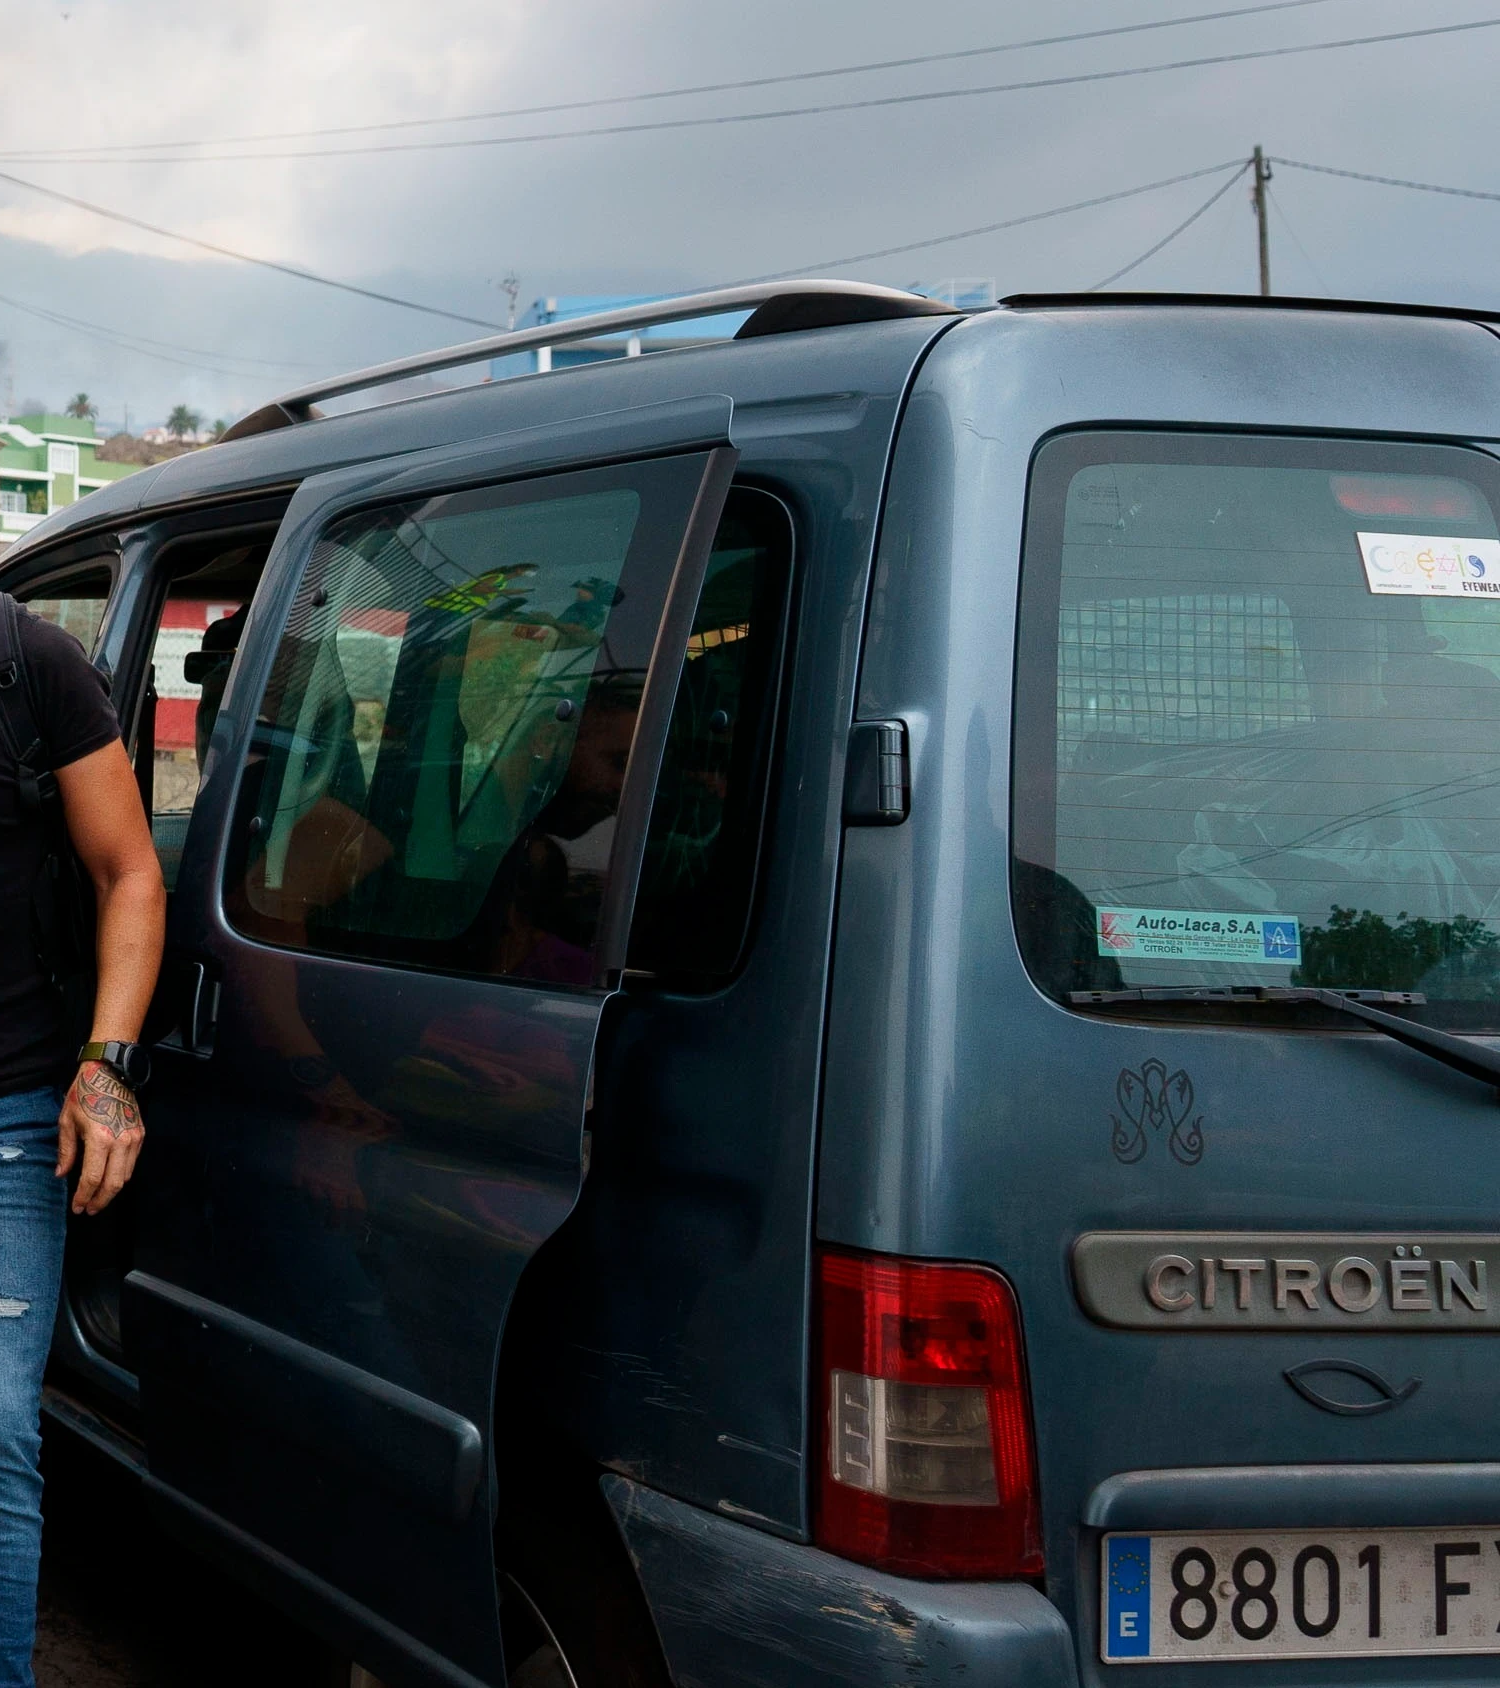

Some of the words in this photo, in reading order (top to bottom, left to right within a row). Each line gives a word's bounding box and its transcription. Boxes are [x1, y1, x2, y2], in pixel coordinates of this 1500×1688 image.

[1462, 581, 1500, 593] EYEWEA
[1147, 1245, 1488, 1313] CITROËN
[1170, 1544, 1381, 1641] 8801
[1120, 1612, 1139, 1637] E
